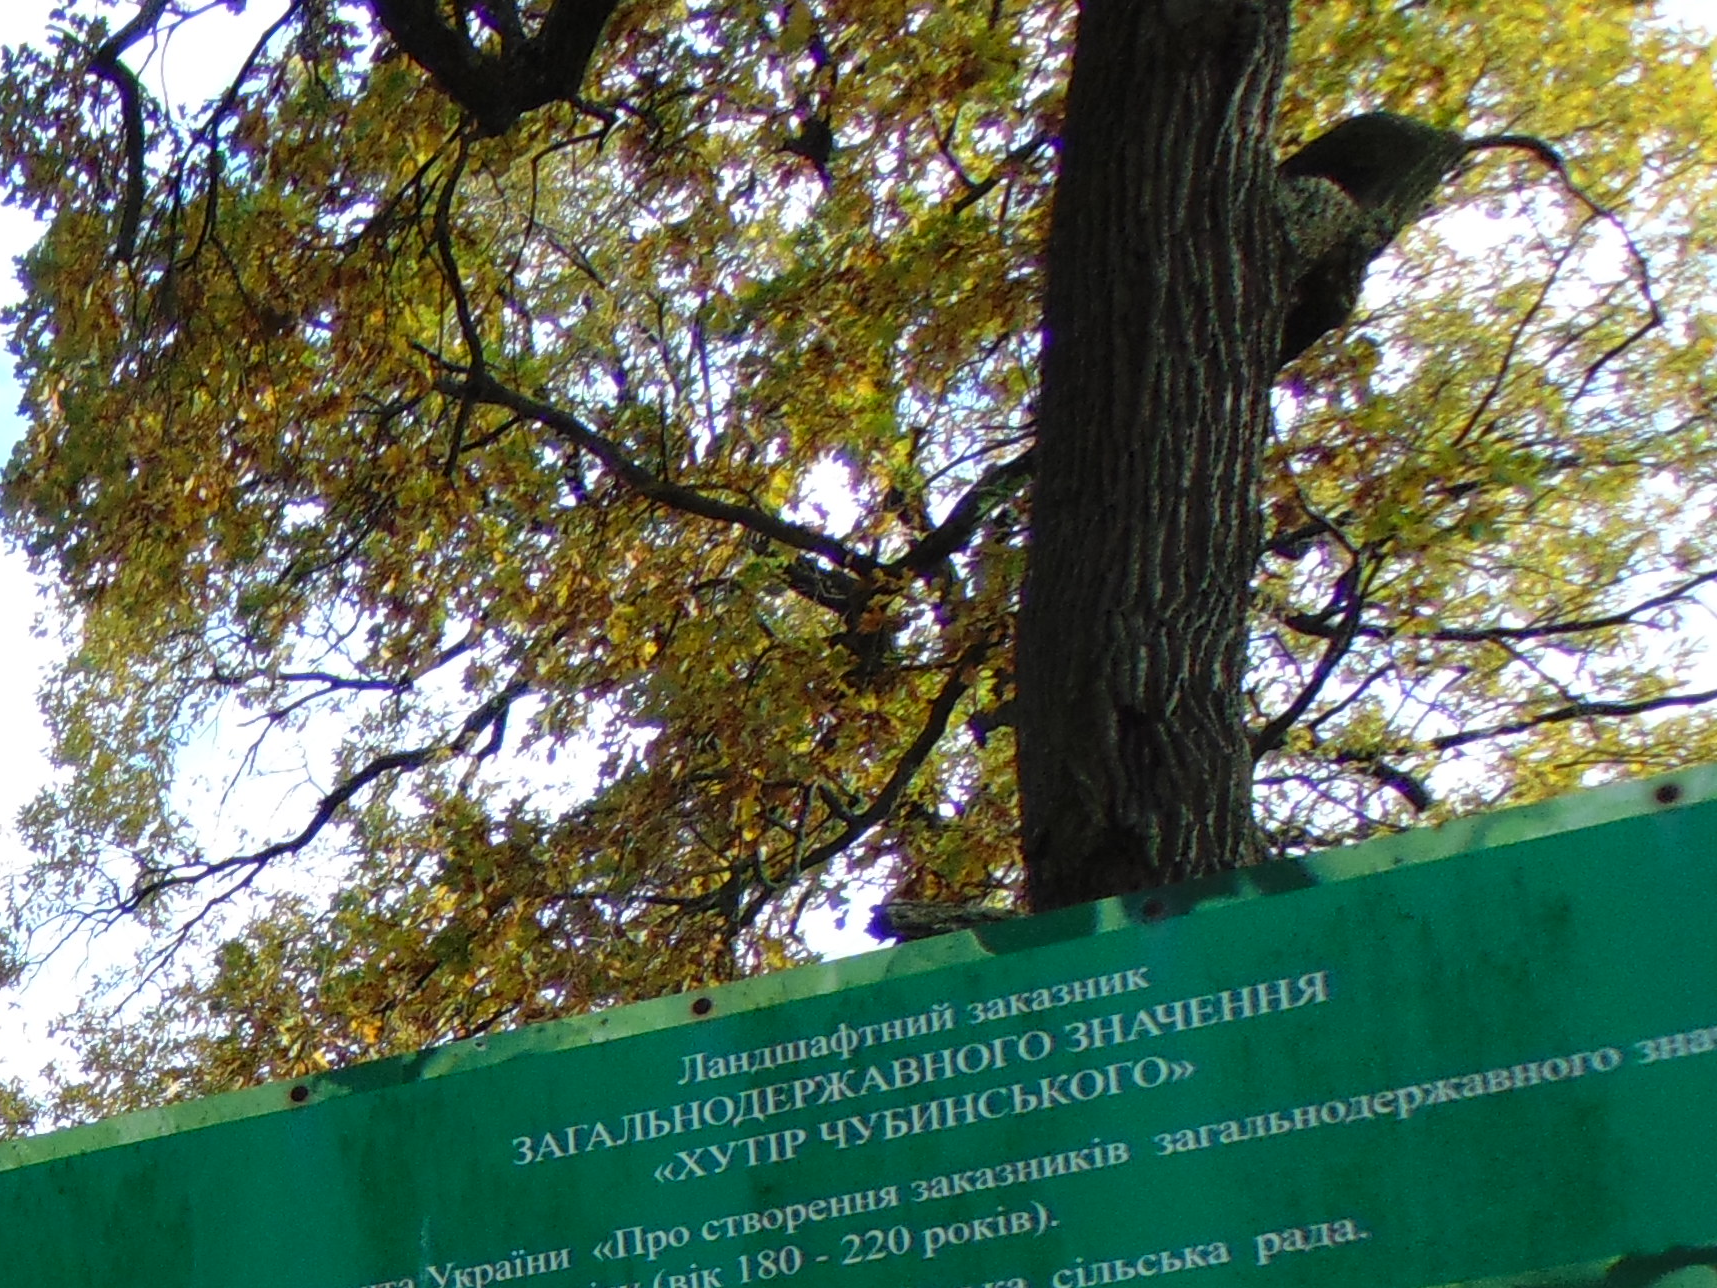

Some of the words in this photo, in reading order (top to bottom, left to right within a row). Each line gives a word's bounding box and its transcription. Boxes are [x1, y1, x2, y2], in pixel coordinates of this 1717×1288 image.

[512, 1026, 1053, 1166] ЗАГАЛЬНОДЕРЖАВНОГО
[1065, 970, 1330, 1052] ЗНАЧЕННЯ
[678, 1005, 955, 1086] Ландшафтний
[966, 967, 1150, 1025] заказник
[592, 1223, 691, 1263] «Про
[701, 1184, 898, 1242] створення
[910, 1137, 1129, 1206] заказників
[1156, 1046, 1620, 1156] загальнодержавного
[1635, 1026, 1717, 1064] зна
[654, 1129, 808, 1186] «ХУТІР
[818, 1056, 1196, 1149] ЧУБИНСЬКОГО»
[738, 1243, 802, 1284] 180
[840, 1224, 911, 1266] 220
[922, 1201, 1060, 1257] років).
[1256, 1213, 1372, 1265] рада.
